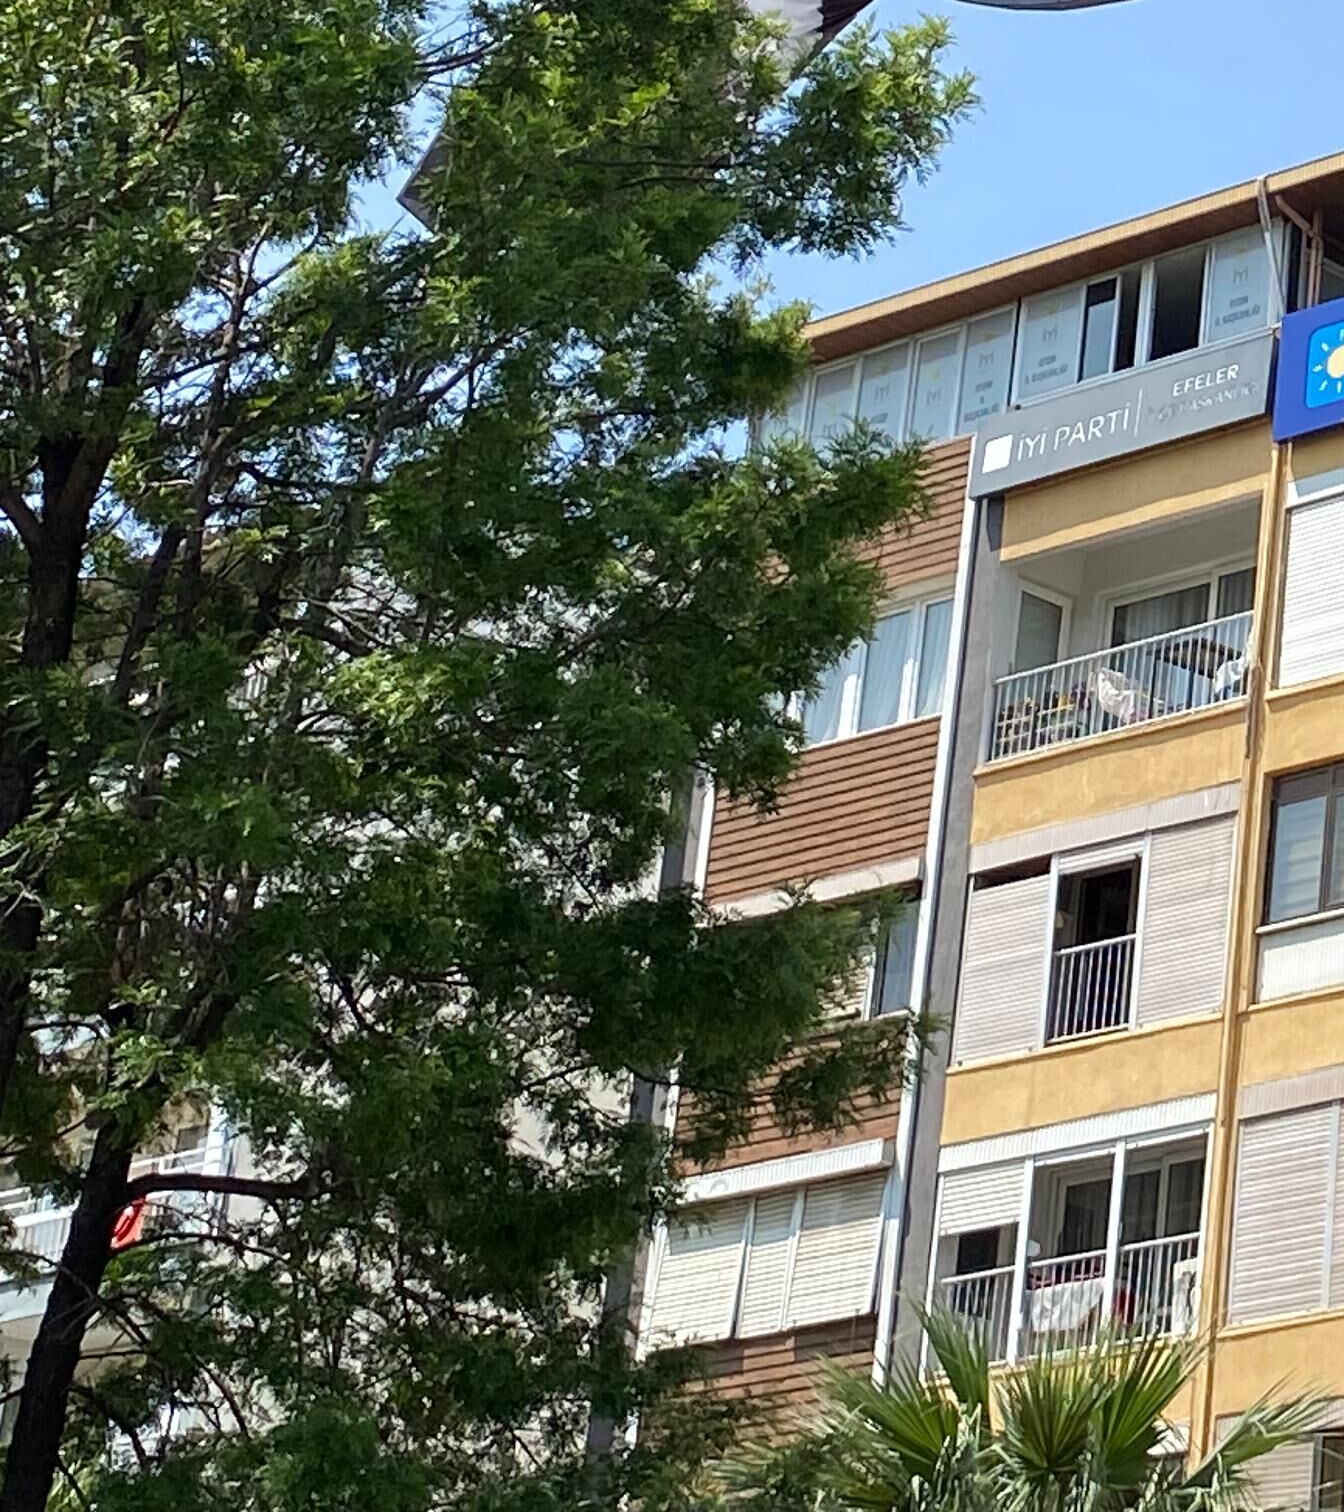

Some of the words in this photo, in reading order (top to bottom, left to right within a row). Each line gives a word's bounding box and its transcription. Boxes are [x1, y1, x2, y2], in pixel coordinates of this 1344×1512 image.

[1172, 364, 1240, 397] EFELER
[1016, 426, 1047, 462] İYİ
[1053, 402, 1132, 451] PARTİ
